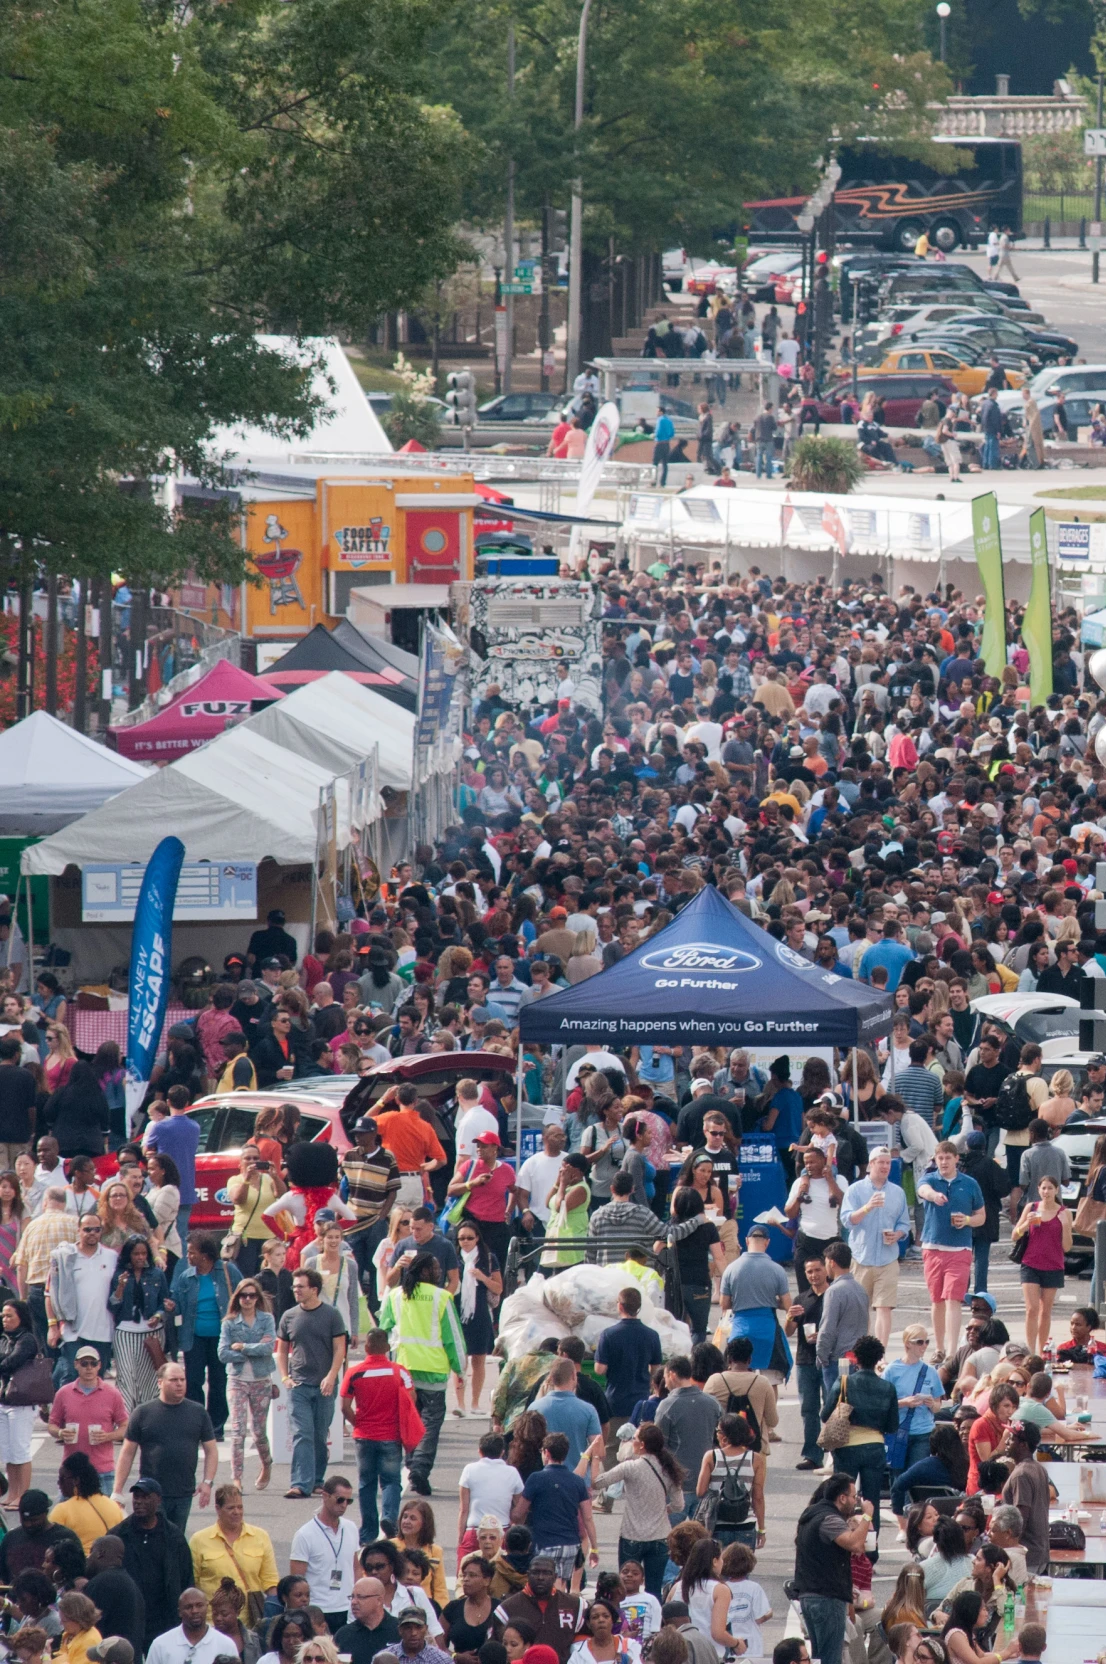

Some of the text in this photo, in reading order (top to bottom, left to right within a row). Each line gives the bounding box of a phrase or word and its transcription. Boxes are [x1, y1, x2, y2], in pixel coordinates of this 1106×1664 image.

[343, 527, 373, 539] FOOD
[1059, 527, 1089, 542] BEVERAGES
[343, 539, 388, 552] SAFETY
[135, 741, 152, 750] IT'S
[156, 738, 189, 750] BETTER
[240, 873, 252, 881] DC
[661, 946, 738, 970] Ford
[655, 978, 739, 991] Go Further
[137, 932, 166, 1051] ESCAPE
[559, 1017, 819, 1034] Amazing happens when you Go Further
